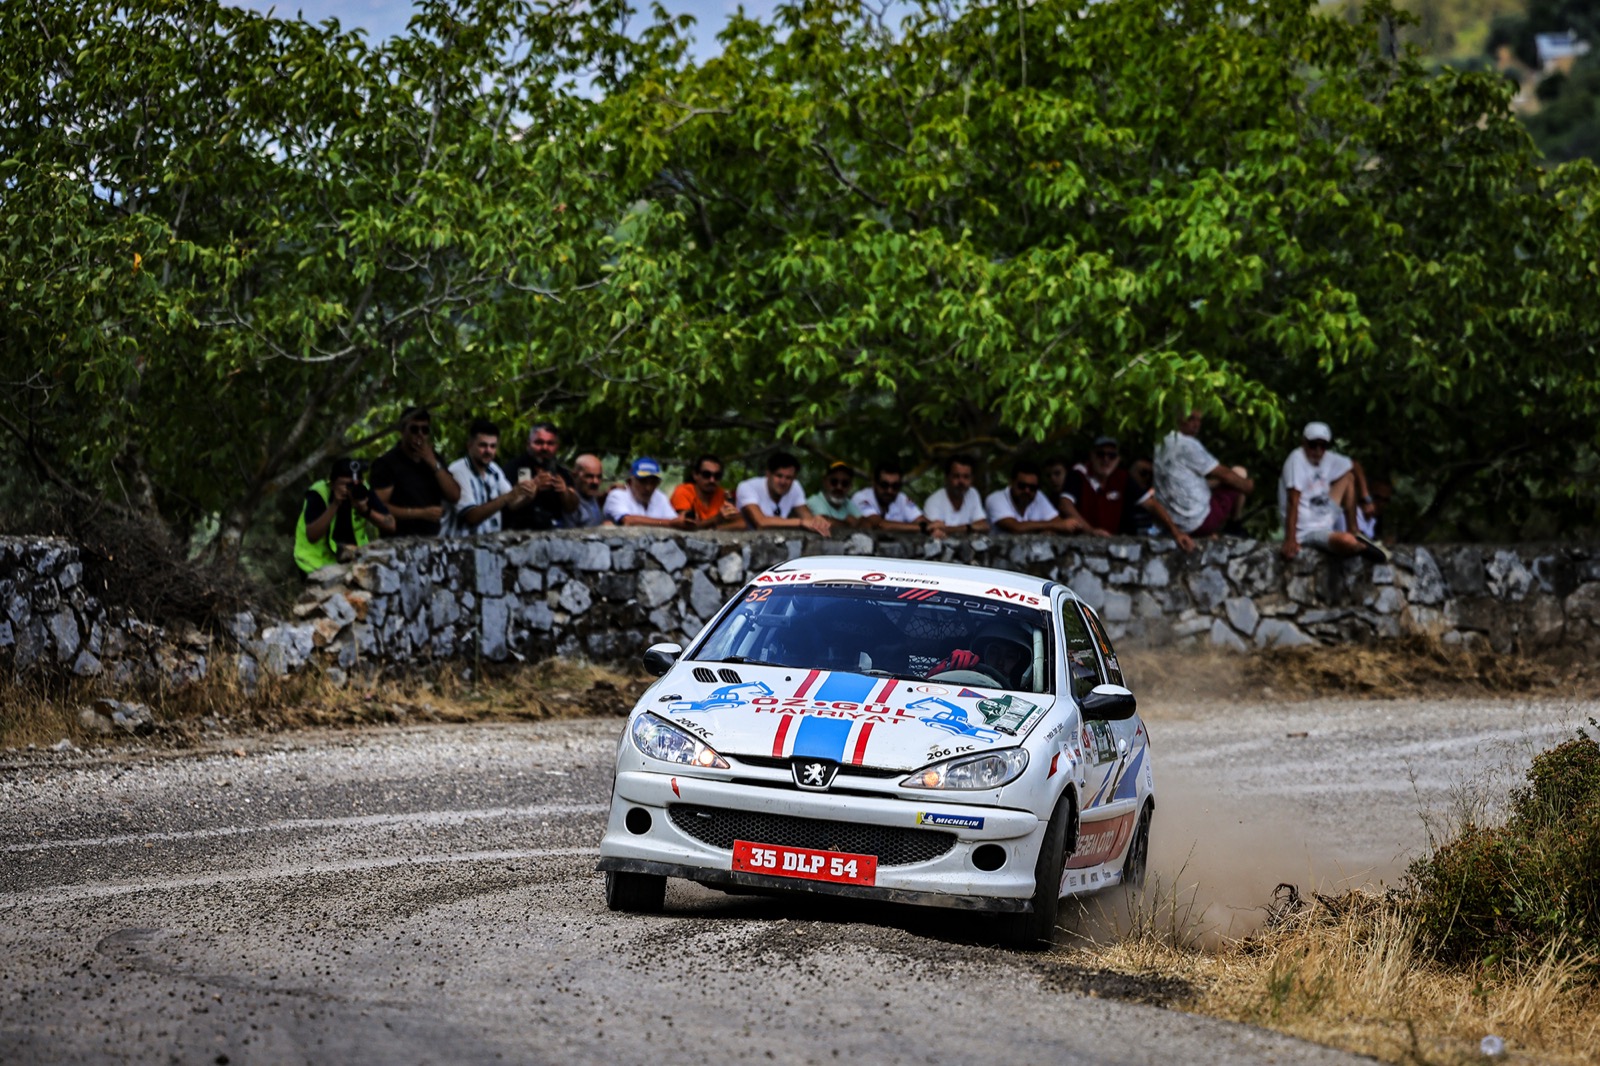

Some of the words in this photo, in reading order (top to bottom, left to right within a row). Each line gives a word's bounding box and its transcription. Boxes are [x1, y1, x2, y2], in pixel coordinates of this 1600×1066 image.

[756, 573, 812, 583] AVIS
[746, 588, 773, 602] 52
[985, 588, 1040, 606] AVIS
[926, 596, 1019, 615] SPORT
[675, 717, 699, 729] 206
[697, 726, 714, 739] RC
[926, 748, 952, 761] 206
[955, 744, 976, 754] RC
[935, 817, 980, 827] MICHELIN
[749, 847, 777, 869] 35
[782, 851, 825, 874] DLP
[830, 857, 859, 879] 54
